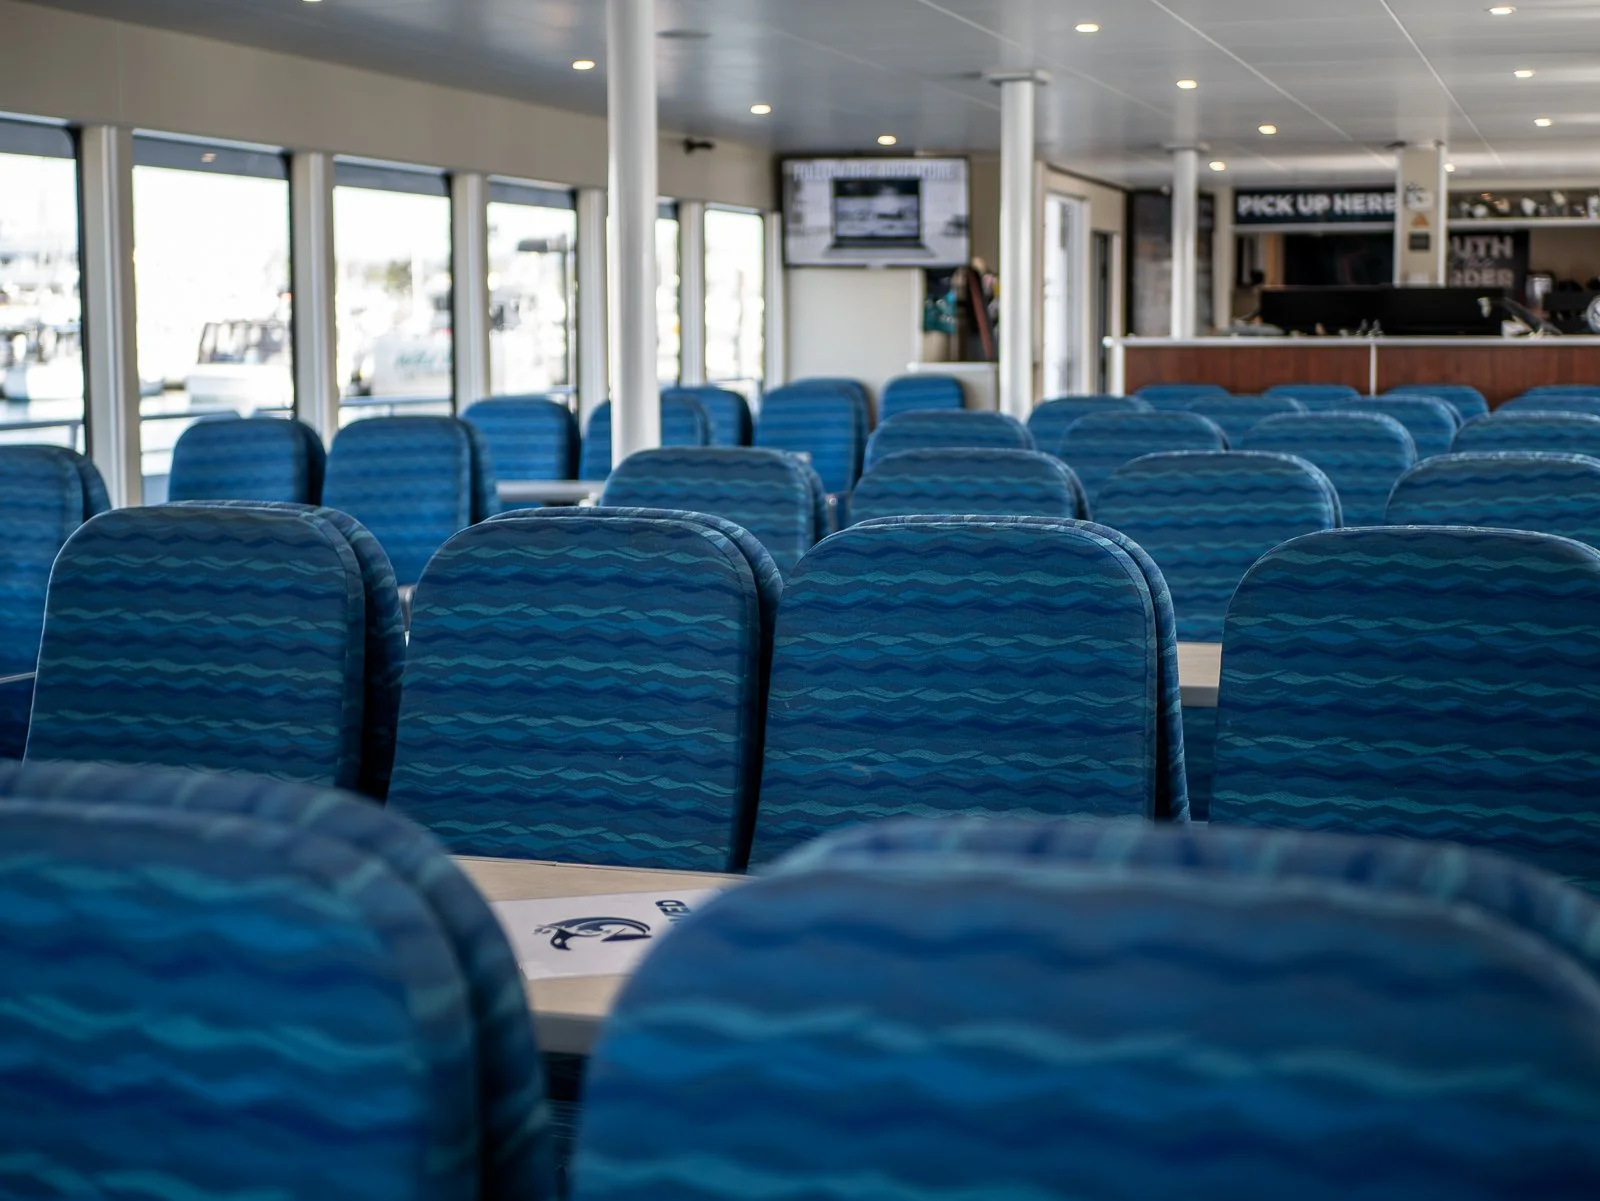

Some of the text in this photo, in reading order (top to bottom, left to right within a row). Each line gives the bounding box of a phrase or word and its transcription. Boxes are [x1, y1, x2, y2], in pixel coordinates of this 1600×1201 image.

[1237, 192, 1395, 216] PICK UP HERE
[1450, 235, 1513, 258] UTH
